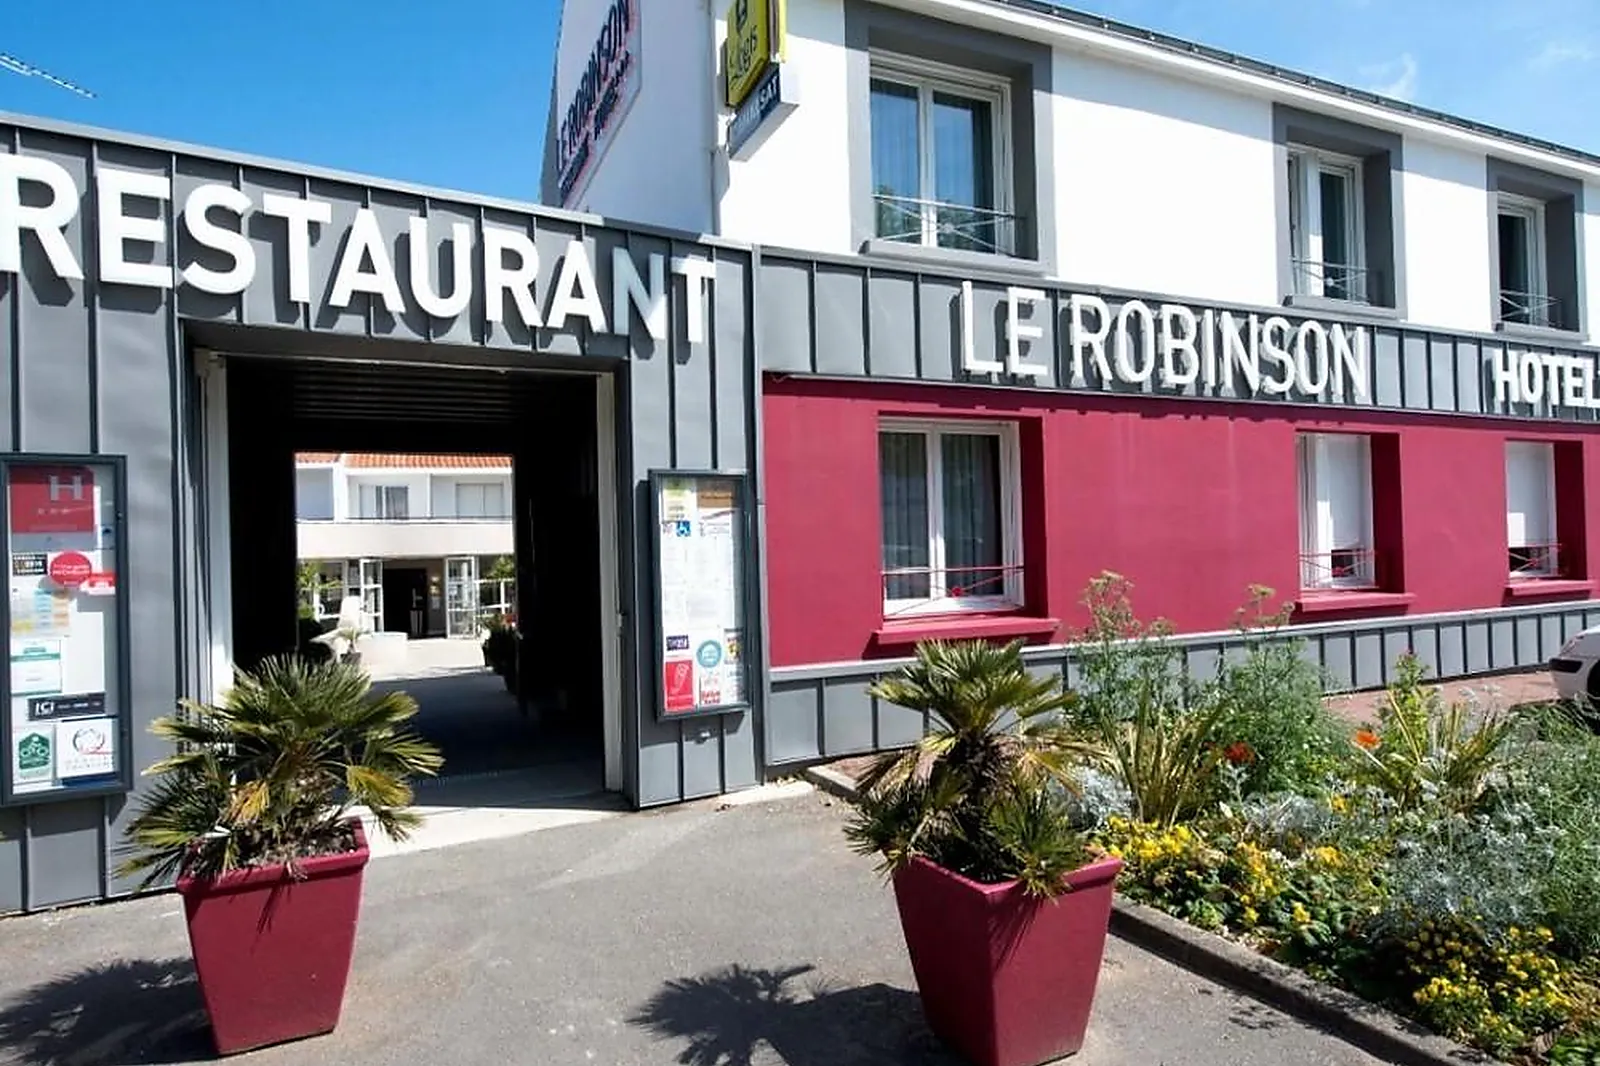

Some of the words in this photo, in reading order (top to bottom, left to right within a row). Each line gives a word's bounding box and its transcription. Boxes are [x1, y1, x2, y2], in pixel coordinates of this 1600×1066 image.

[0, 153, 716, 343] RESTAURANT
[959, 280, 1048, 376] LE
[1070, 293, 1370, 405] ROBINSON
[1493, 348, 1600, 408] HOTEL
